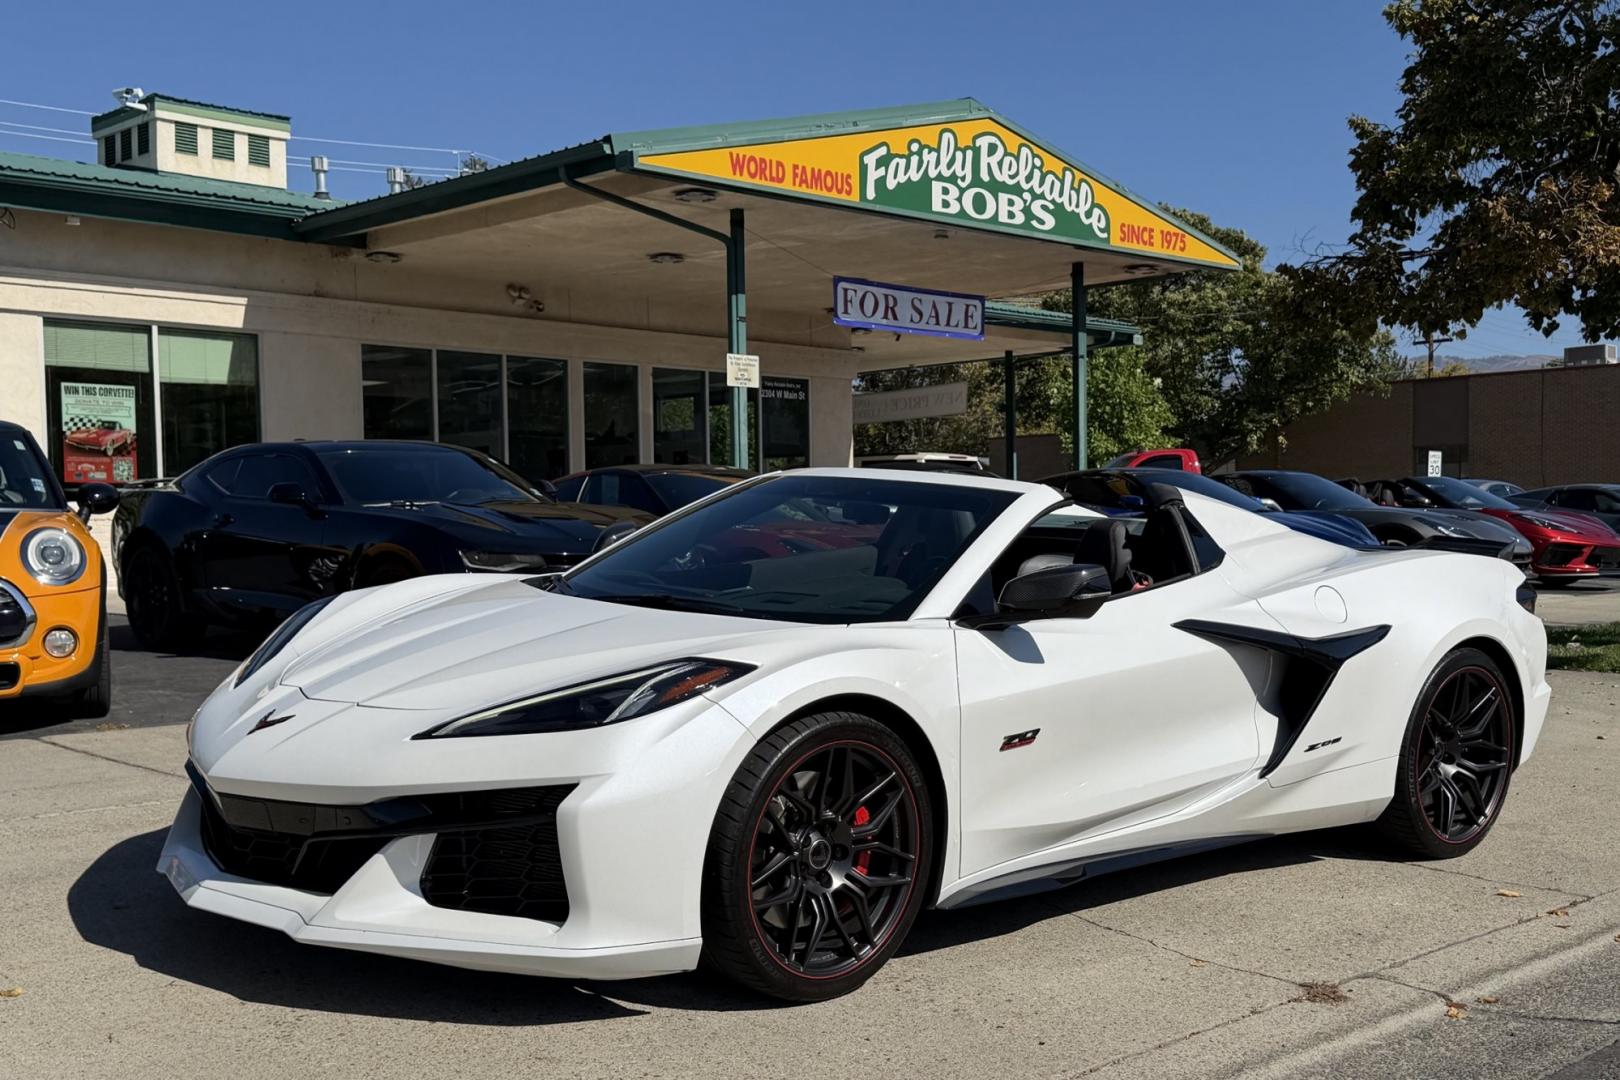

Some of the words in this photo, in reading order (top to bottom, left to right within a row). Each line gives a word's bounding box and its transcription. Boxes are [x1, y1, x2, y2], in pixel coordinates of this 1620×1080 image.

[729, 152, 786, 184] WORLD
[792, 163, 853, 196] FAMOUS
[863, 132, 973, 200] Fairly
[975, 135, 1108, 238] Reliable
[931, 180, 1056, 231] BOB'S
[1120, 222, 1155, 247] SINCE
[1160, 229, 1186, 252] 1975
[841, 287, 899, 321] FOR
[910, 297, 978, 330] SALE
[63, 385, 80, 395] WIN
[81, 386, 98, 396] THIS
[98, 387, 135, 398] CORVETTE!
[776, 390, 783, 399] W
[783, 390, 798, 399] Main
[798, 391, 806, 400] St
[1429, 464, 1440, 475] 30
